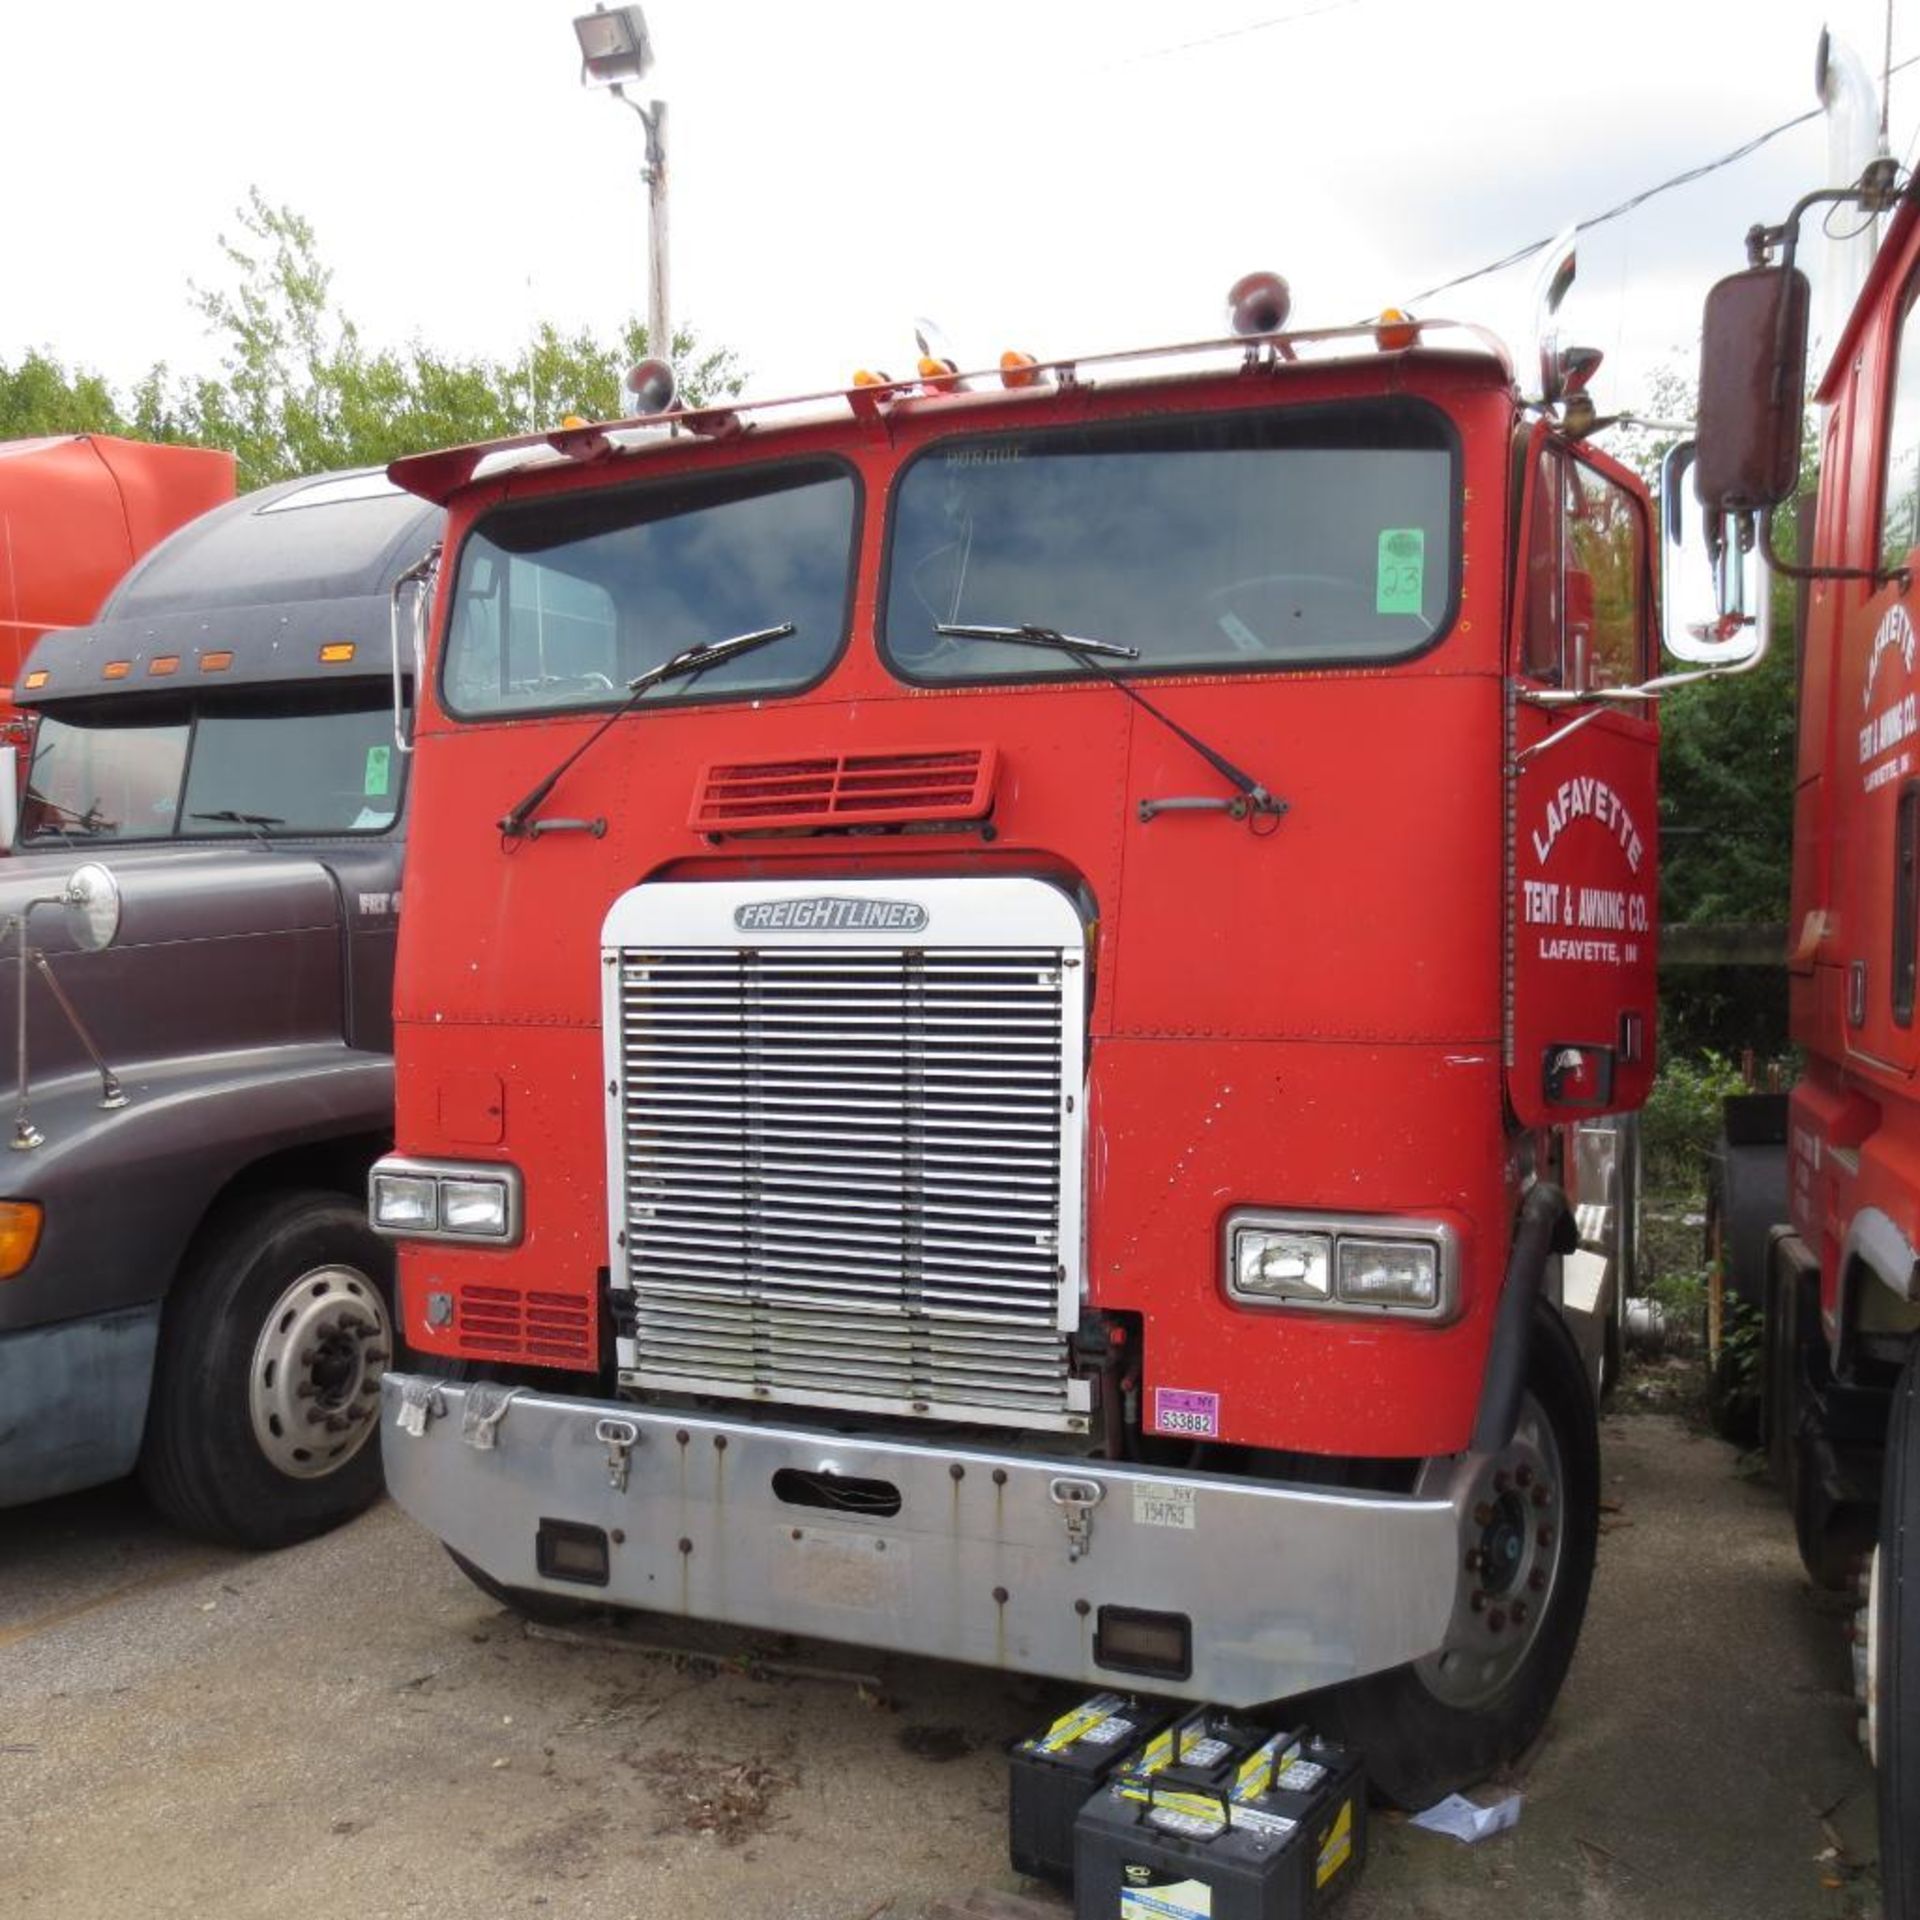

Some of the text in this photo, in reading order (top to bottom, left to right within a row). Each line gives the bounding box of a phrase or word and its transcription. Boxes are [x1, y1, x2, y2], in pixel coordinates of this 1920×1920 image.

[1383, 565, 1419, 597] 23
[1532, 775, 1643, 874] LAFAYETTE
[740, 900, 920, 927] FREIGHTLINER
[1524, 879, 1648, 932] TENT & AWNING CO.
[1539, 937, 1637, 966] LAFAYETTE, IN
[1162, 1411, 1210, 1432] 533882
